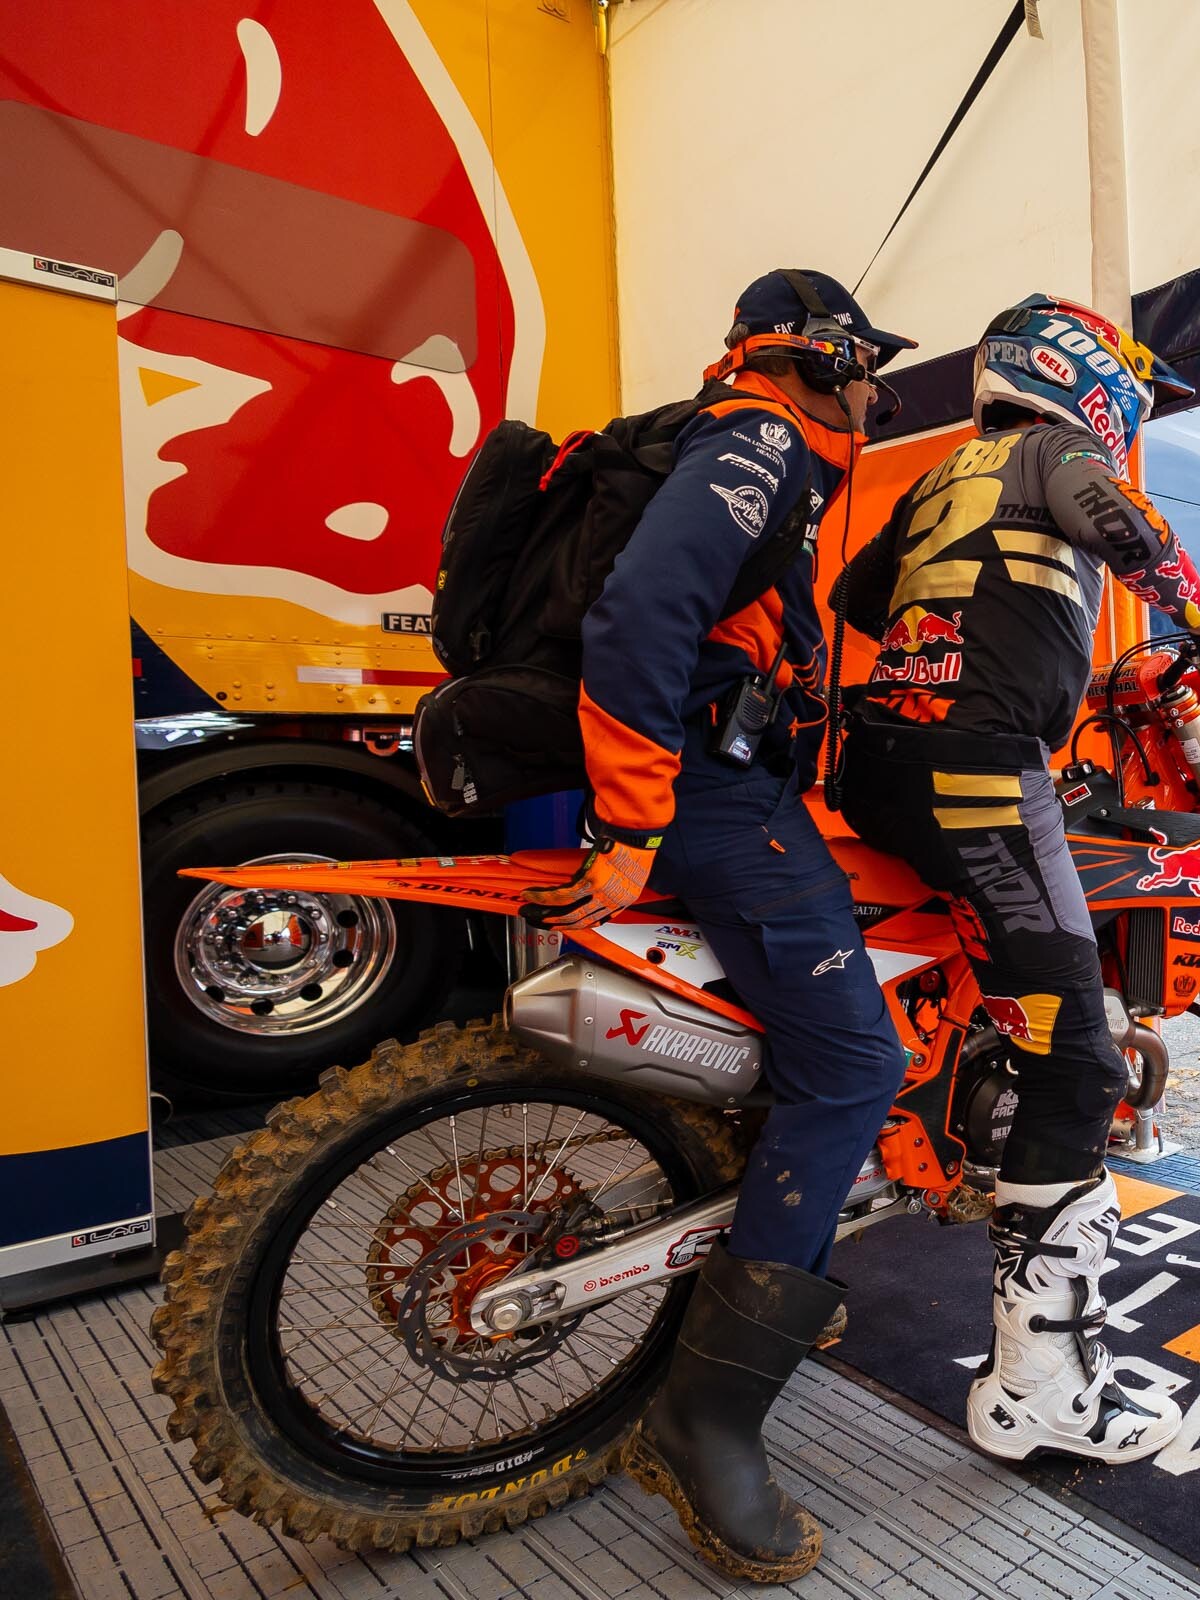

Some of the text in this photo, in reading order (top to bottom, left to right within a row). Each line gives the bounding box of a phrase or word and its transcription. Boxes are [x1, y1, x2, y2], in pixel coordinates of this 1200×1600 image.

[1036, 350, 1069, 382] BELL
[732, 431, 751, 443] LOMA
[1073, 480, 1150, 567] THOR
[889, 477, 1003, 620] 2
[909, 652, 962, 685] Bull
[958, 832, 1061, 934] THOR
[655, 926, 702, 940] AMA
[656, 941, 699, 960] SMX
[641, 1024, 750, 1075] AKRAPOVIČ
[599, 1263, 650, 1288] brembo
